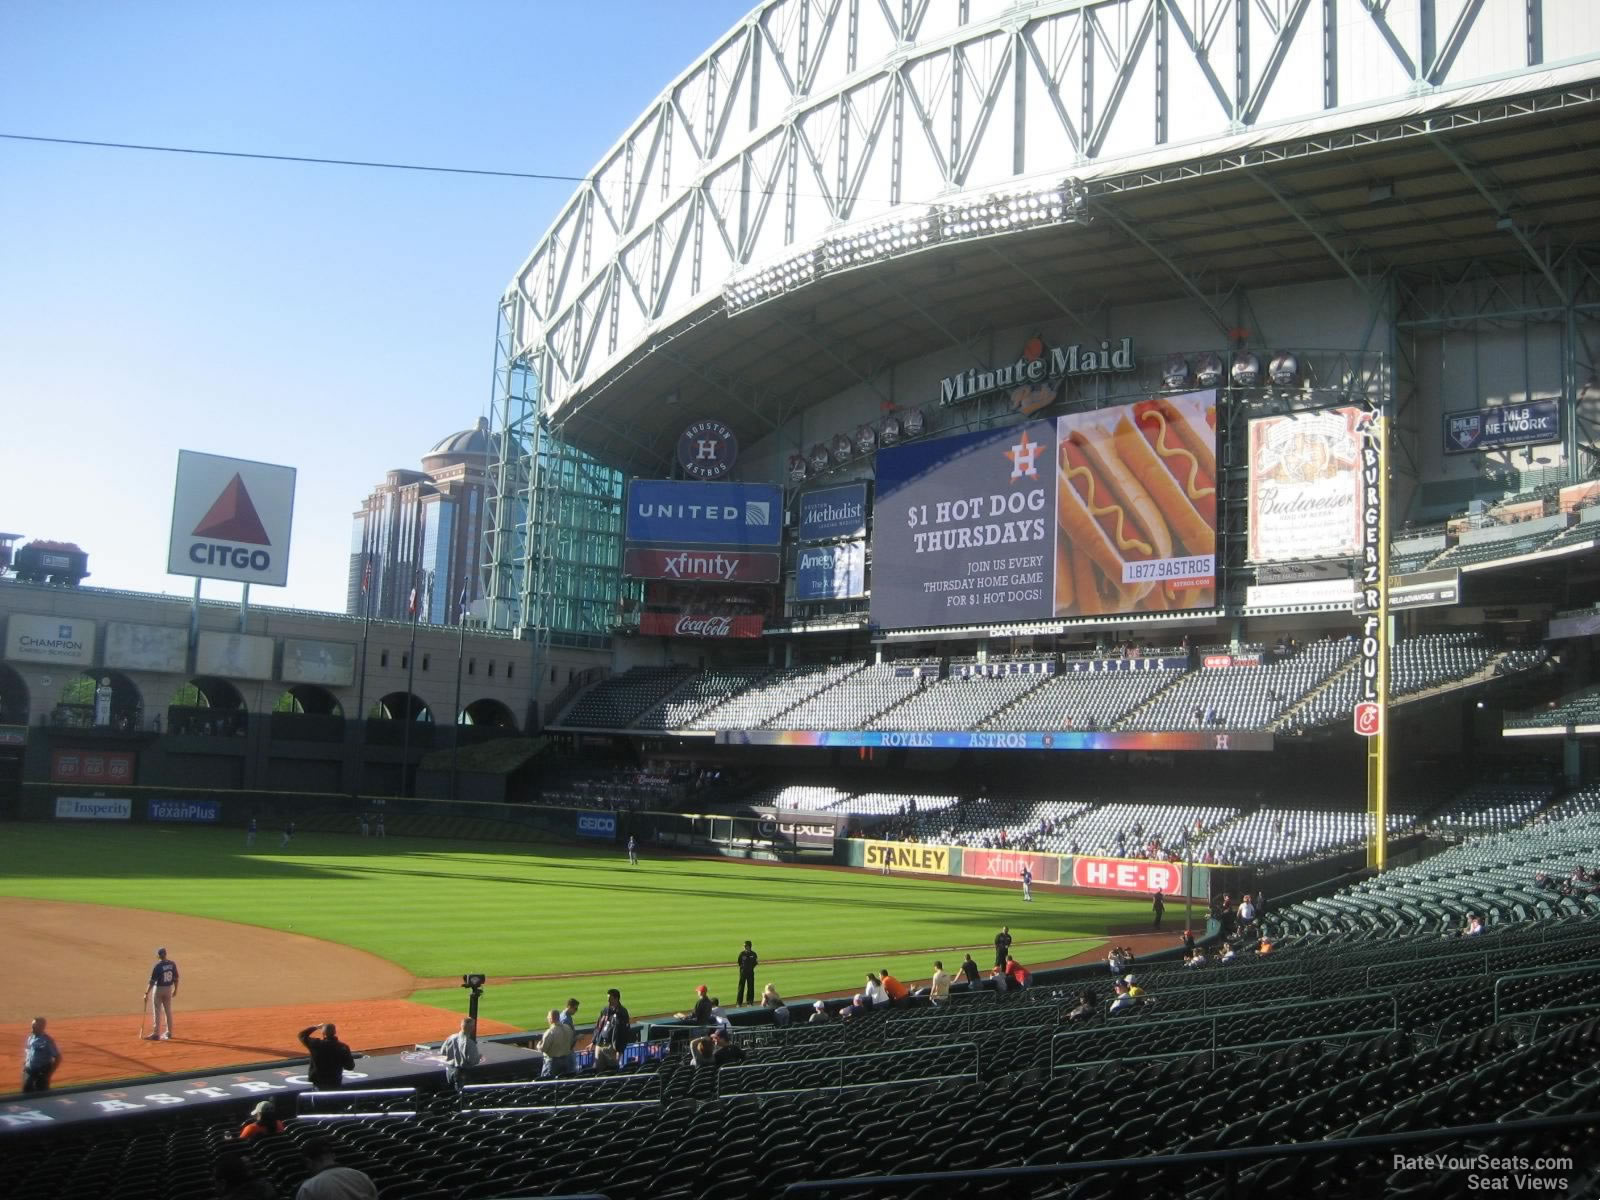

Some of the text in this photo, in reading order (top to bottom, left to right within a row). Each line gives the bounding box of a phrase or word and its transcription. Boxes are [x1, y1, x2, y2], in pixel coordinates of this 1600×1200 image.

[939, 337, 1136, 407] Minute Maid
[1452, 417, 1479, 432] MLB
[1503, 408, 1530, 422] MLB
[686, 422, 731, 440] HOUSTON
[1485, 416, 1548, 436] NETWORK
[695, 439, 718, 460] H
[1010, 441, 1038, 478] H
[686, 461, 728, 477] ASTROS
[907, 488, 1045, 528] $1 HOT DOG
[1257, 486, 1353, 515] Budweiser
[638, 503, 738, 521] UNITED
[804, 500, 862, 525] Methodist
[1362, 449, 1381, 583] BURGERZ
[914, 518, 1045, 553] THURSDAYS
[189, 542, 271, 572] CITGO
[663, 553, 740, 579] xfinity
[800, 553, 836, 570] Amegy
[967, 555, 1043, 575] JOIN US EVERY
[1128, 558, 1211, 579] 1.877.9ASTROS
[923, 571, 1043, 593] THURSDAY HOME GAME
[946, 588, 1042, 607] FOR $1 HOT DOGS!
[1404, 592, 1435, 603] ADVANTAGE
[990, 626, 1063, 637] DAKTRONICS
[19, 634, 83, 650] CHAMPION
[1088, 658, 1164, 672] ASTROS
[1362, 617, 1378, 699] FOUL
[881, 732, 1026, 747] ROYALS ASTROS
[74, 801, 129, 816] Insperity
[152, 803, 216, 820] TexanPlus
[578, 816, 616, 832] GEICO
[866, 846, 945, 870] STANLEY
[986, 854, 1034, 874] xfinity
[1086, 862, 1169, 889] H-E-B
[163, 970, 173, 983] 18
